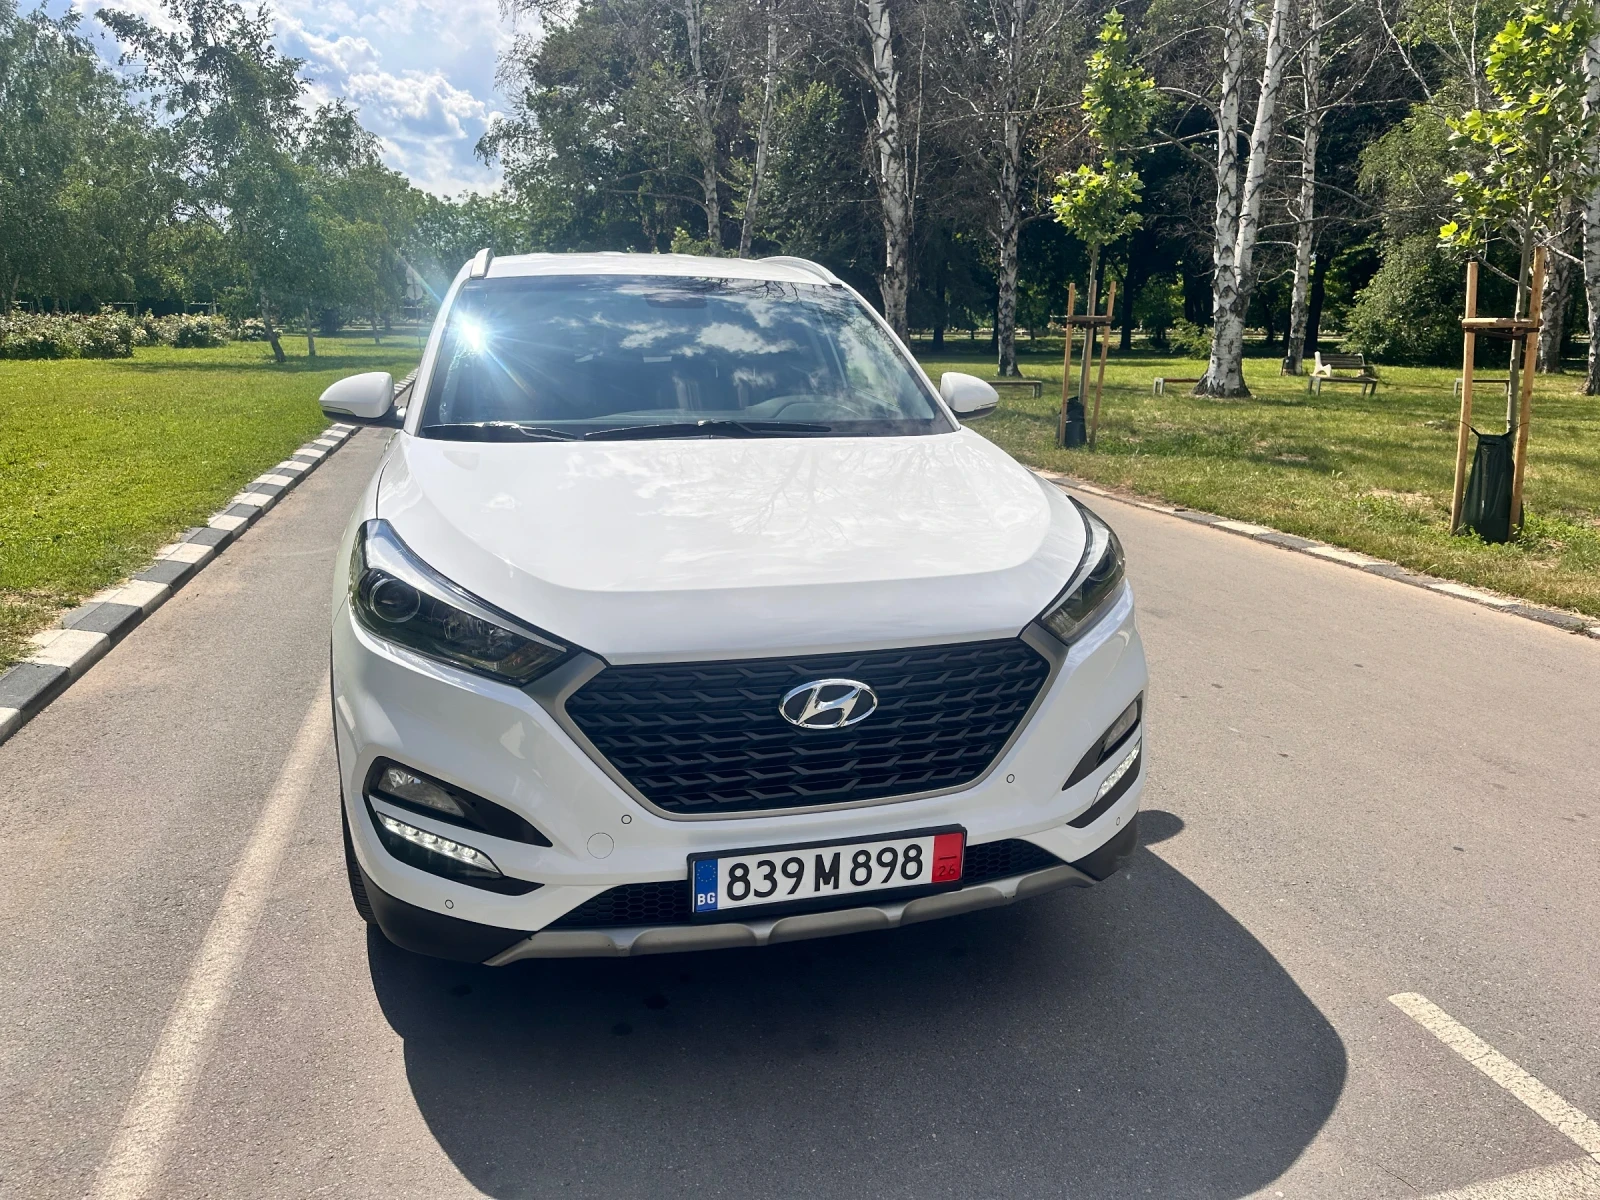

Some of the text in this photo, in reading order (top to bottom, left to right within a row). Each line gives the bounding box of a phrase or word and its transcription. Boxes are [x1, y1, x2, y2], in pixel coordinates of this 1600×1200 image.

[726, 843, 923, 901] 839 M 898
[938, 865, 956, 877] 26
[697, 892, 716, 906] BG
